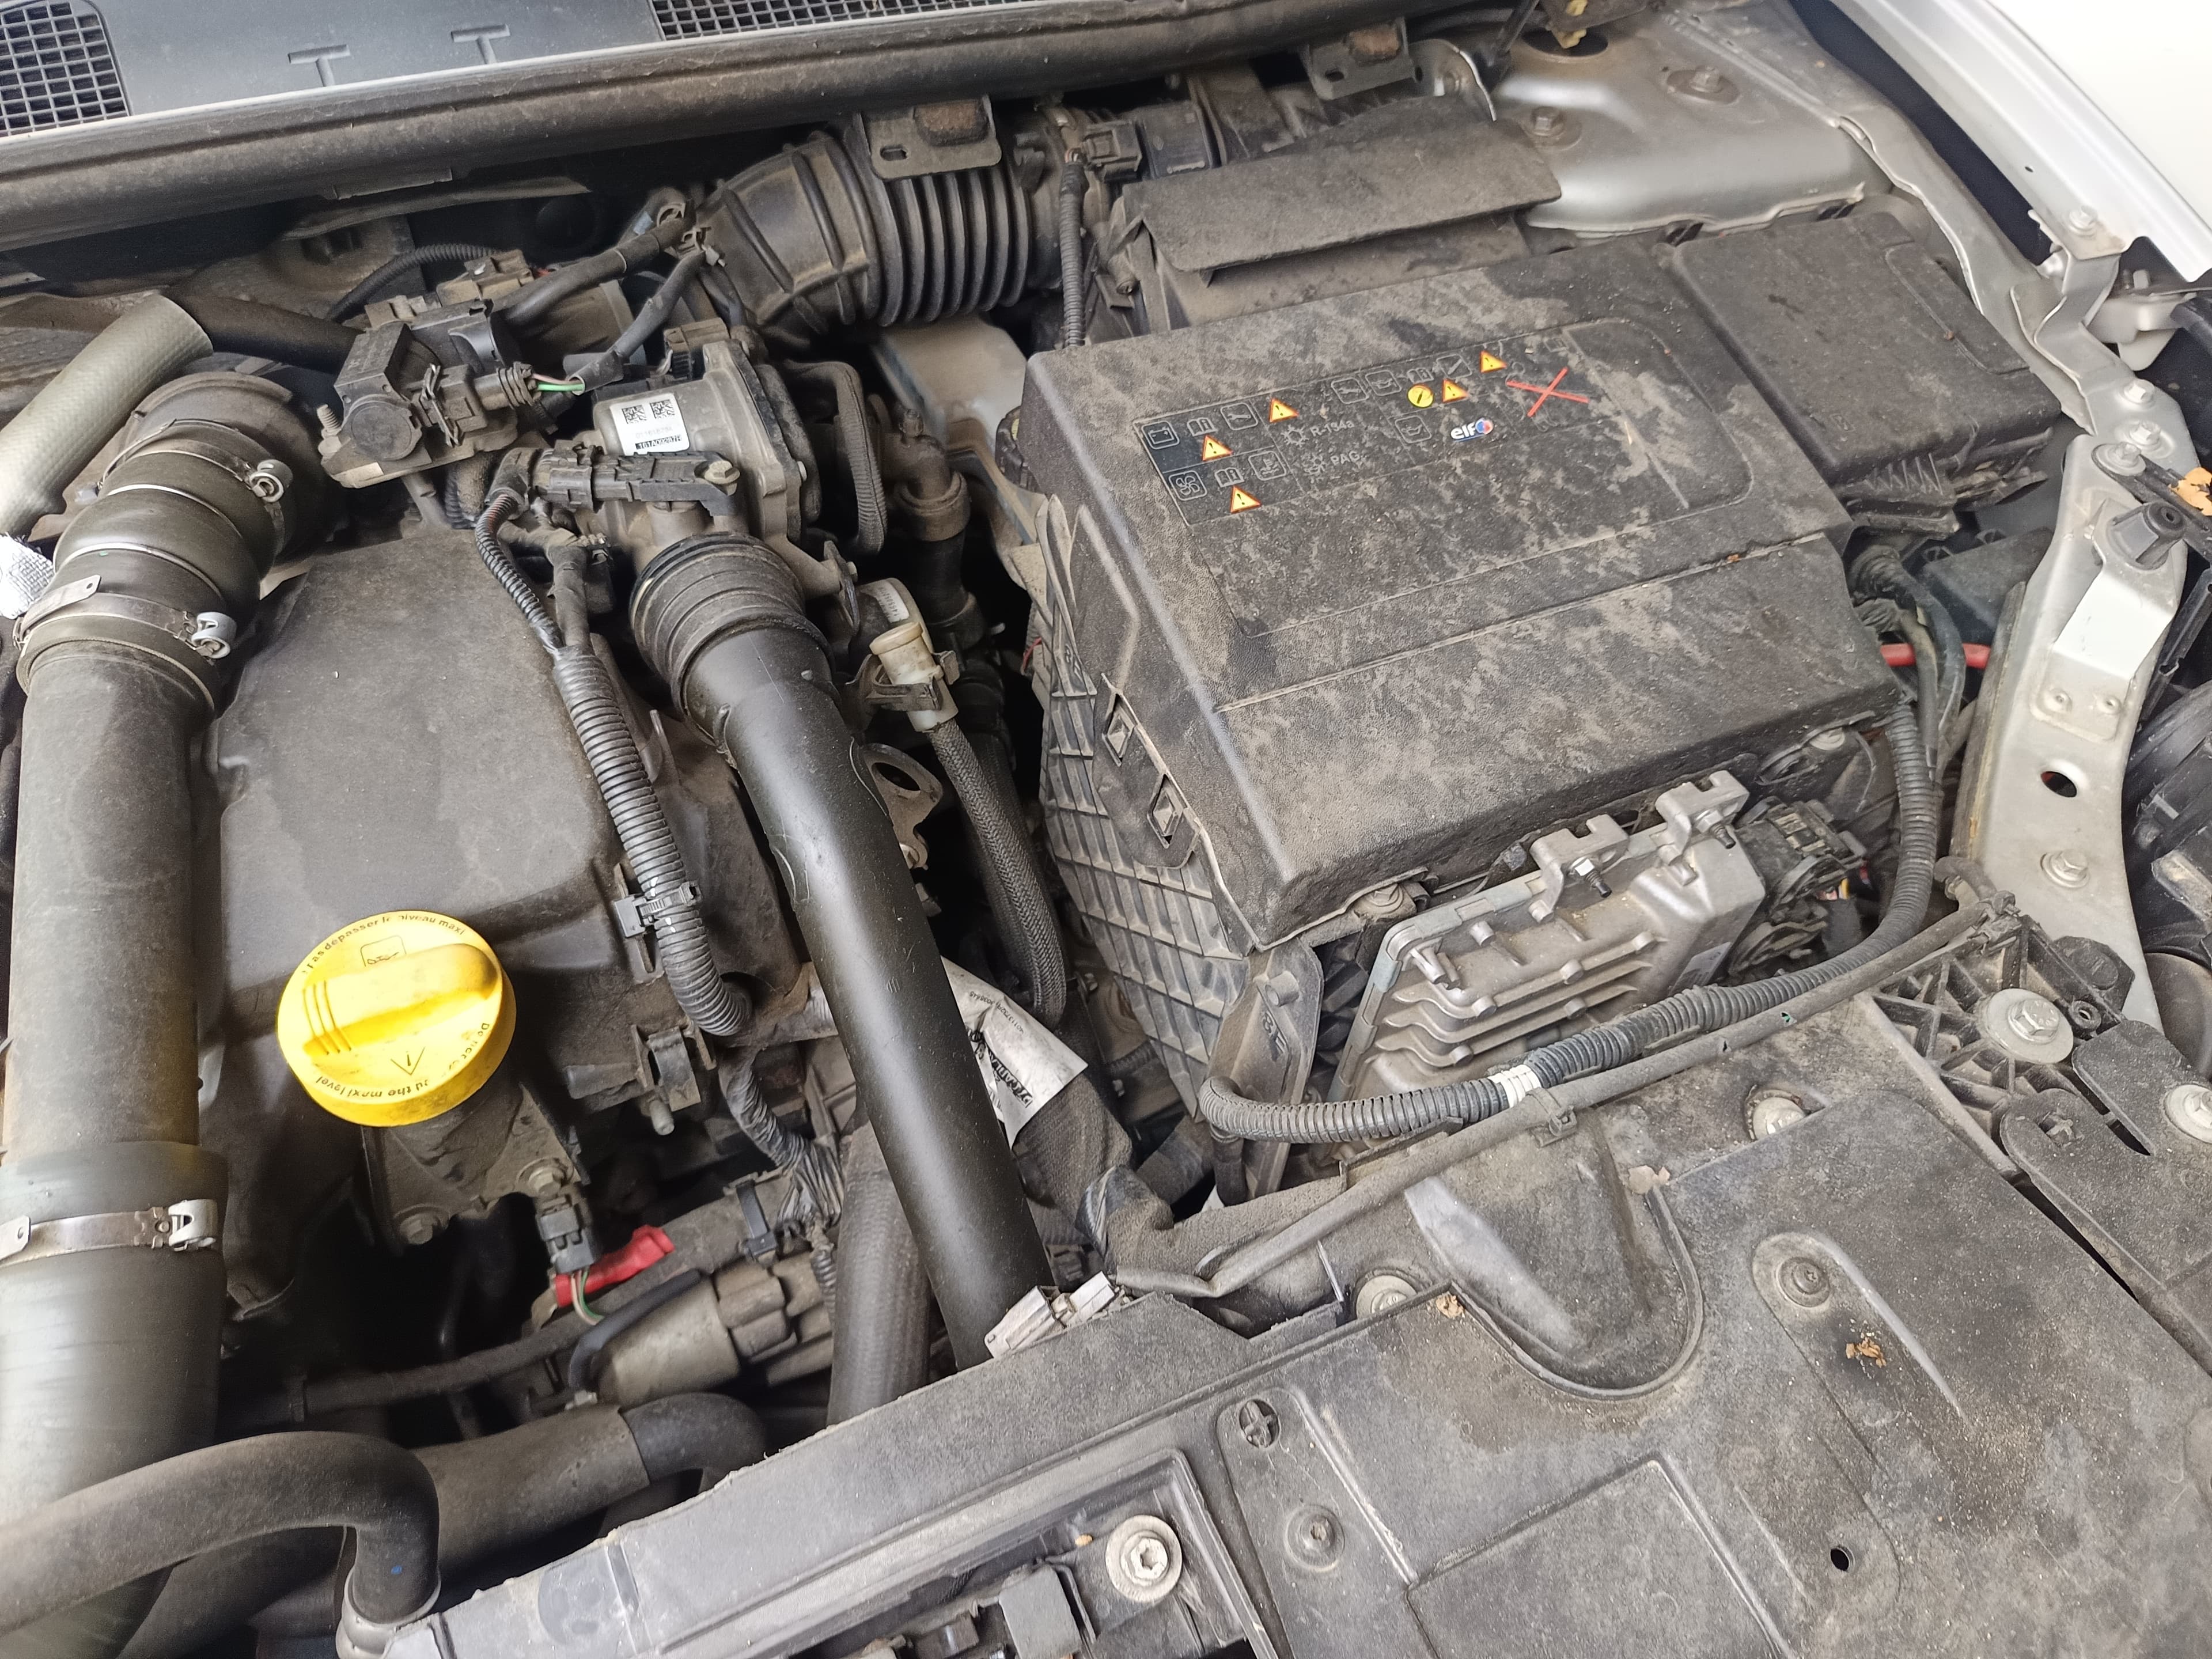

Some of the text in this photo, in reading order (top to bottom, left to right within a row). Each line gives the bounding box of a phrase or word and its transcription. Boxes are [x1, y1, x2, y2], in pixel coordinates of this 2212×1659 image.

[1450, 421, 1476, 440] elf
[438, 919, 465, 935] maxi
[316, 1075, 346, 1095] level
[388, 1086, 411, 1096] the
